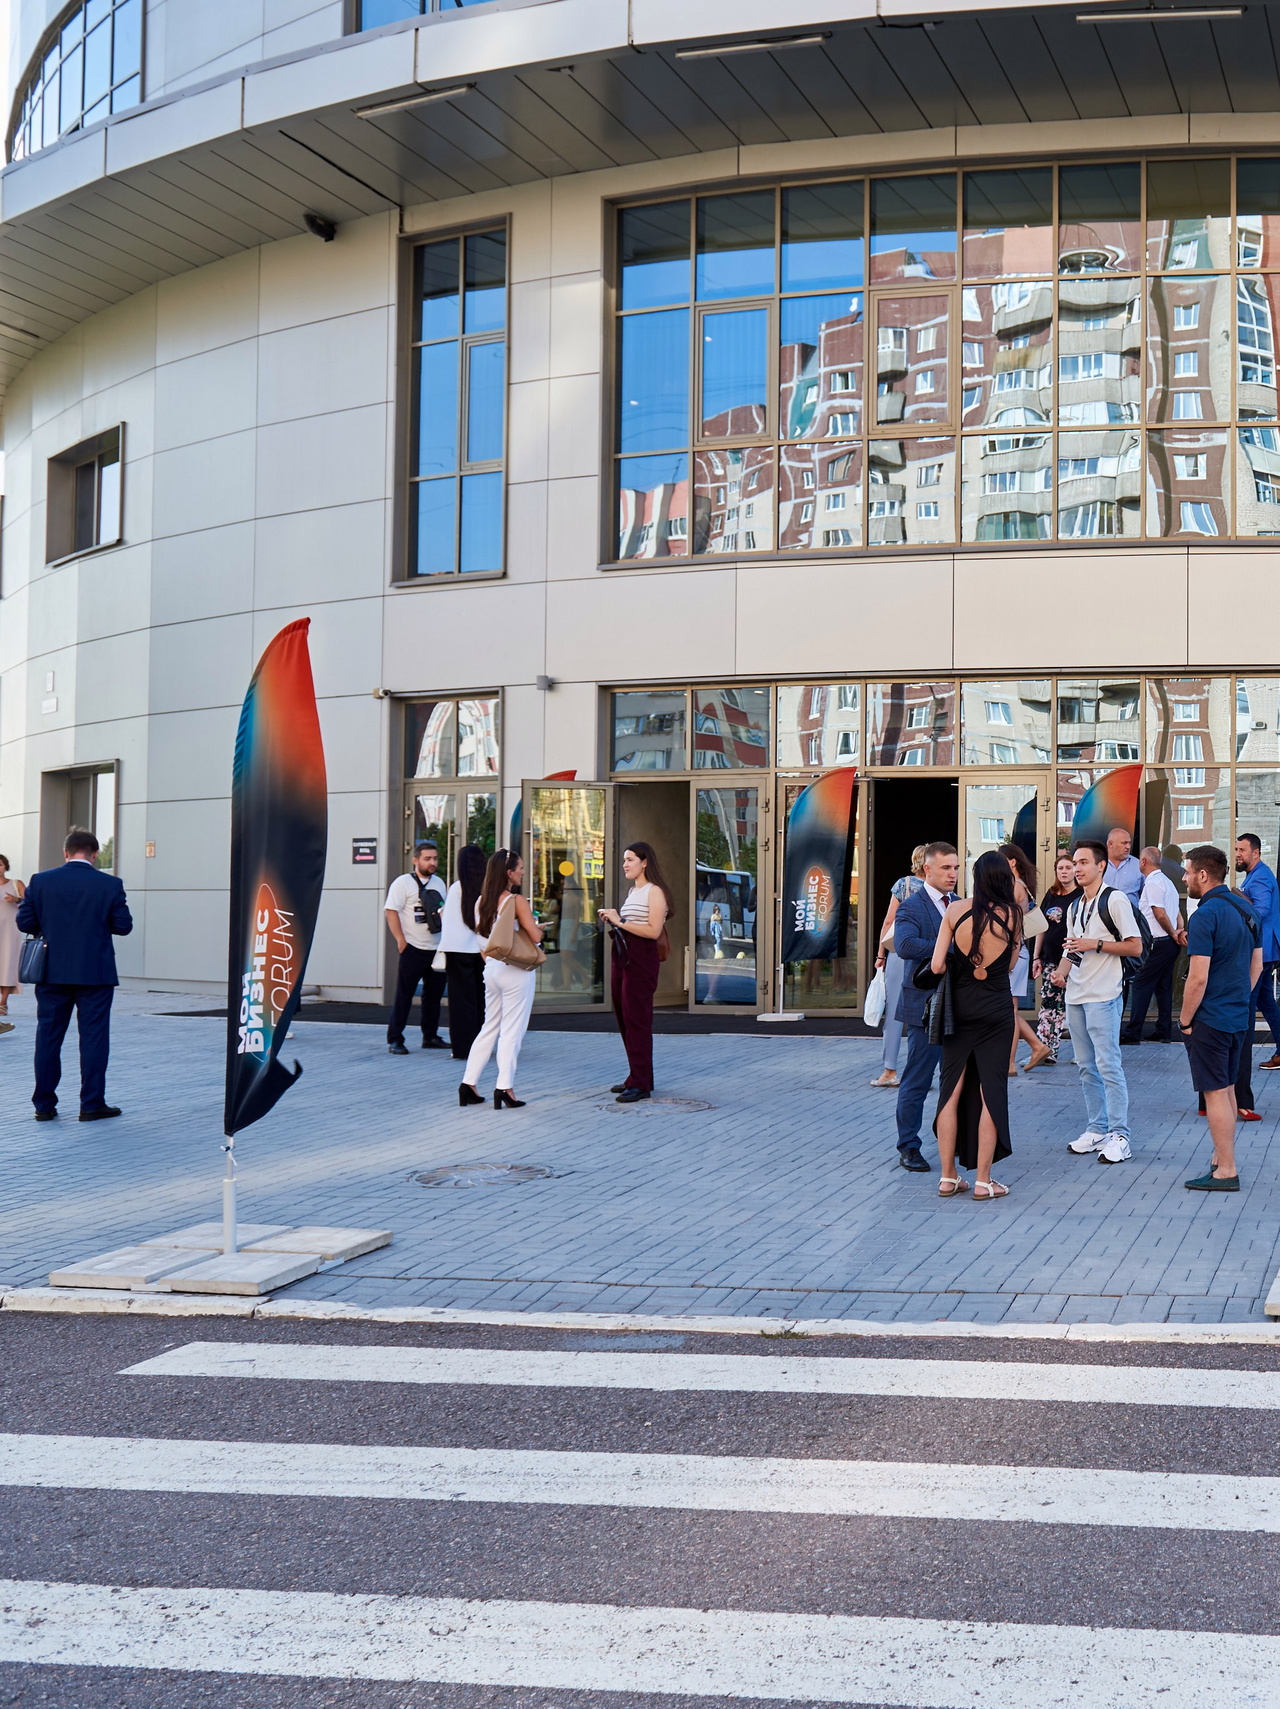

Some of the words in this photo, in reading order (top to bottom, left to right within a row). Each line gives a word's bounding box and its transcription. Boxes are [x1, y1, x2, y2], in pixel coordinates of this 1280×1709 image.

[791, 900, 806, 932] МОЙ
[805, 875, 819, 930] БИЗНЕС
[818, 875, 830, 921] FORUM
[245, 908, 269, 1052] БИЗНЕС
